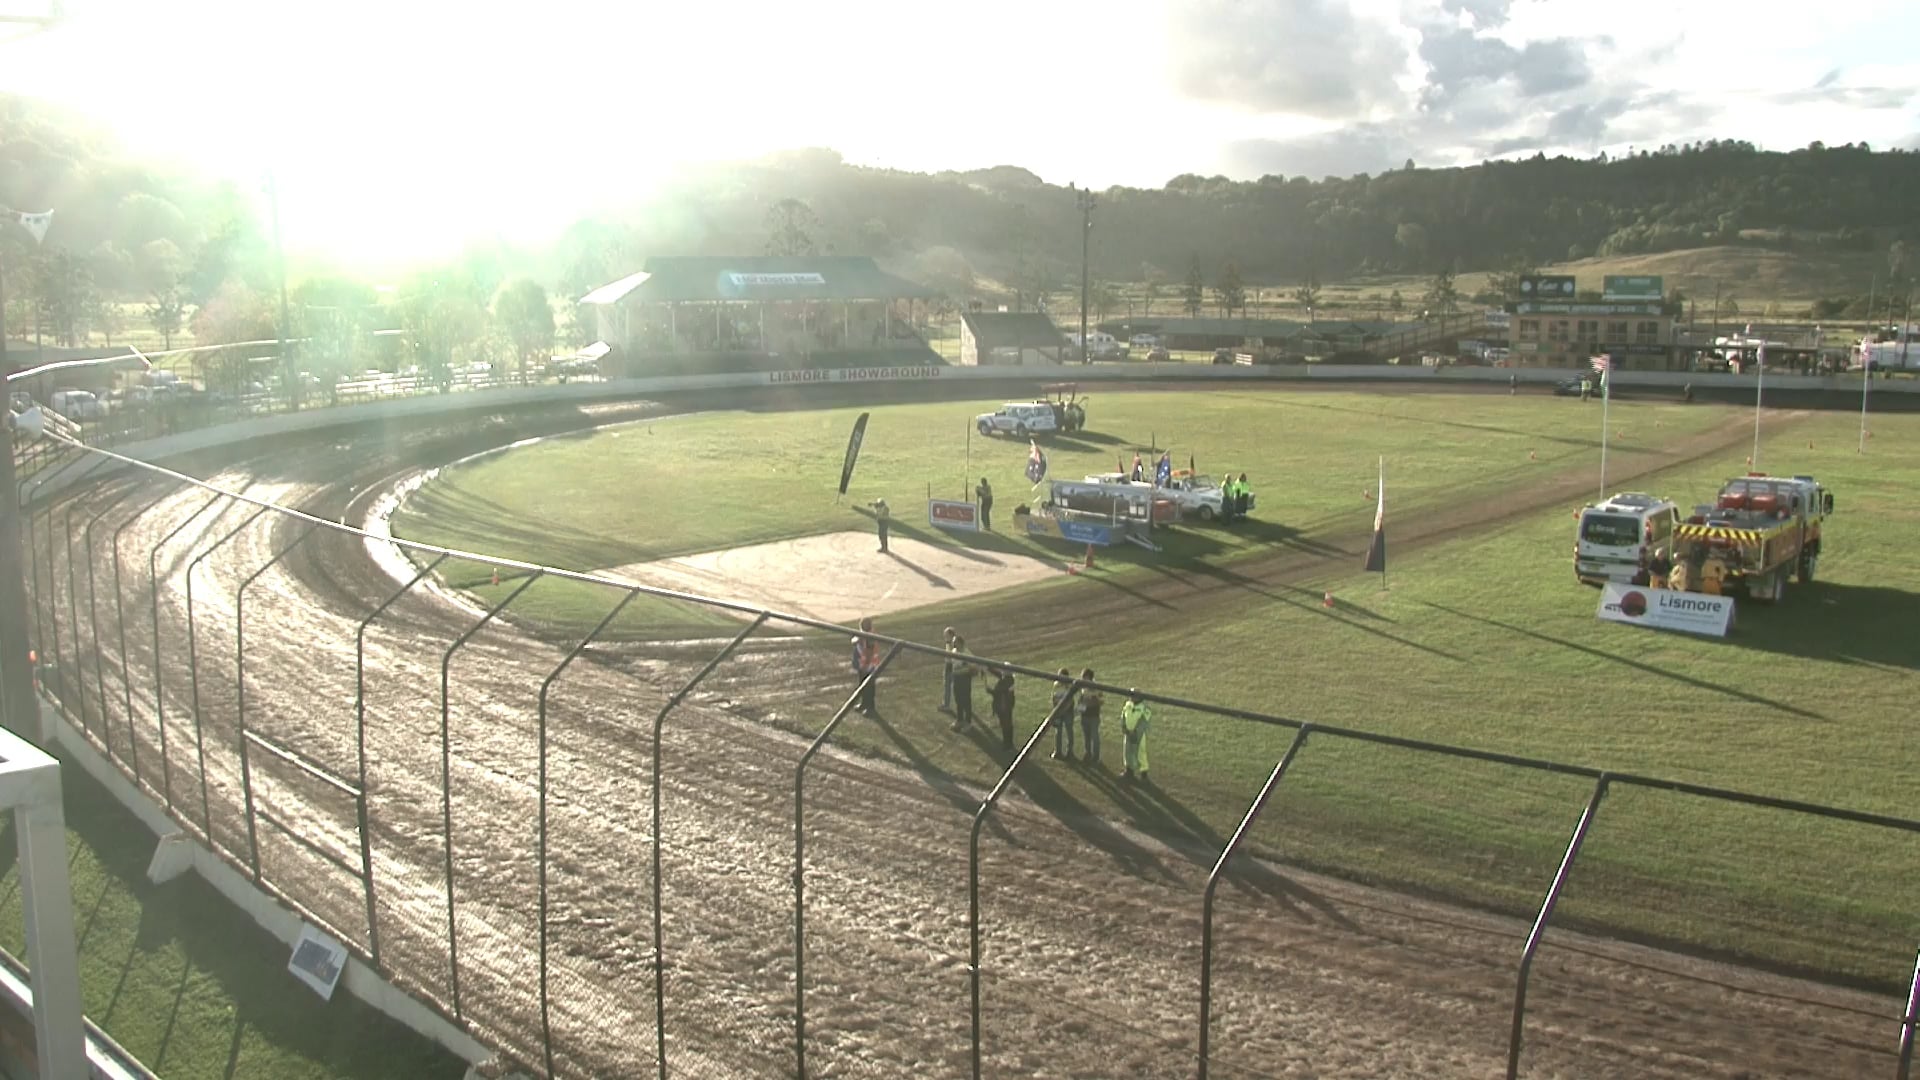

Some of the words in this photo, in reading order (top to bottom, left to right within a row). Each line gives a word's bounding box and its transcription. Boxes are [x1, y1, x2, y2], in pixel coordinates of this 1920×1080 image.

[769, 369, 830, 383] LISMORE
[839, 367, 940, 380] SHOWGROUND
[1659, 594, 1722, 612] Lismore
